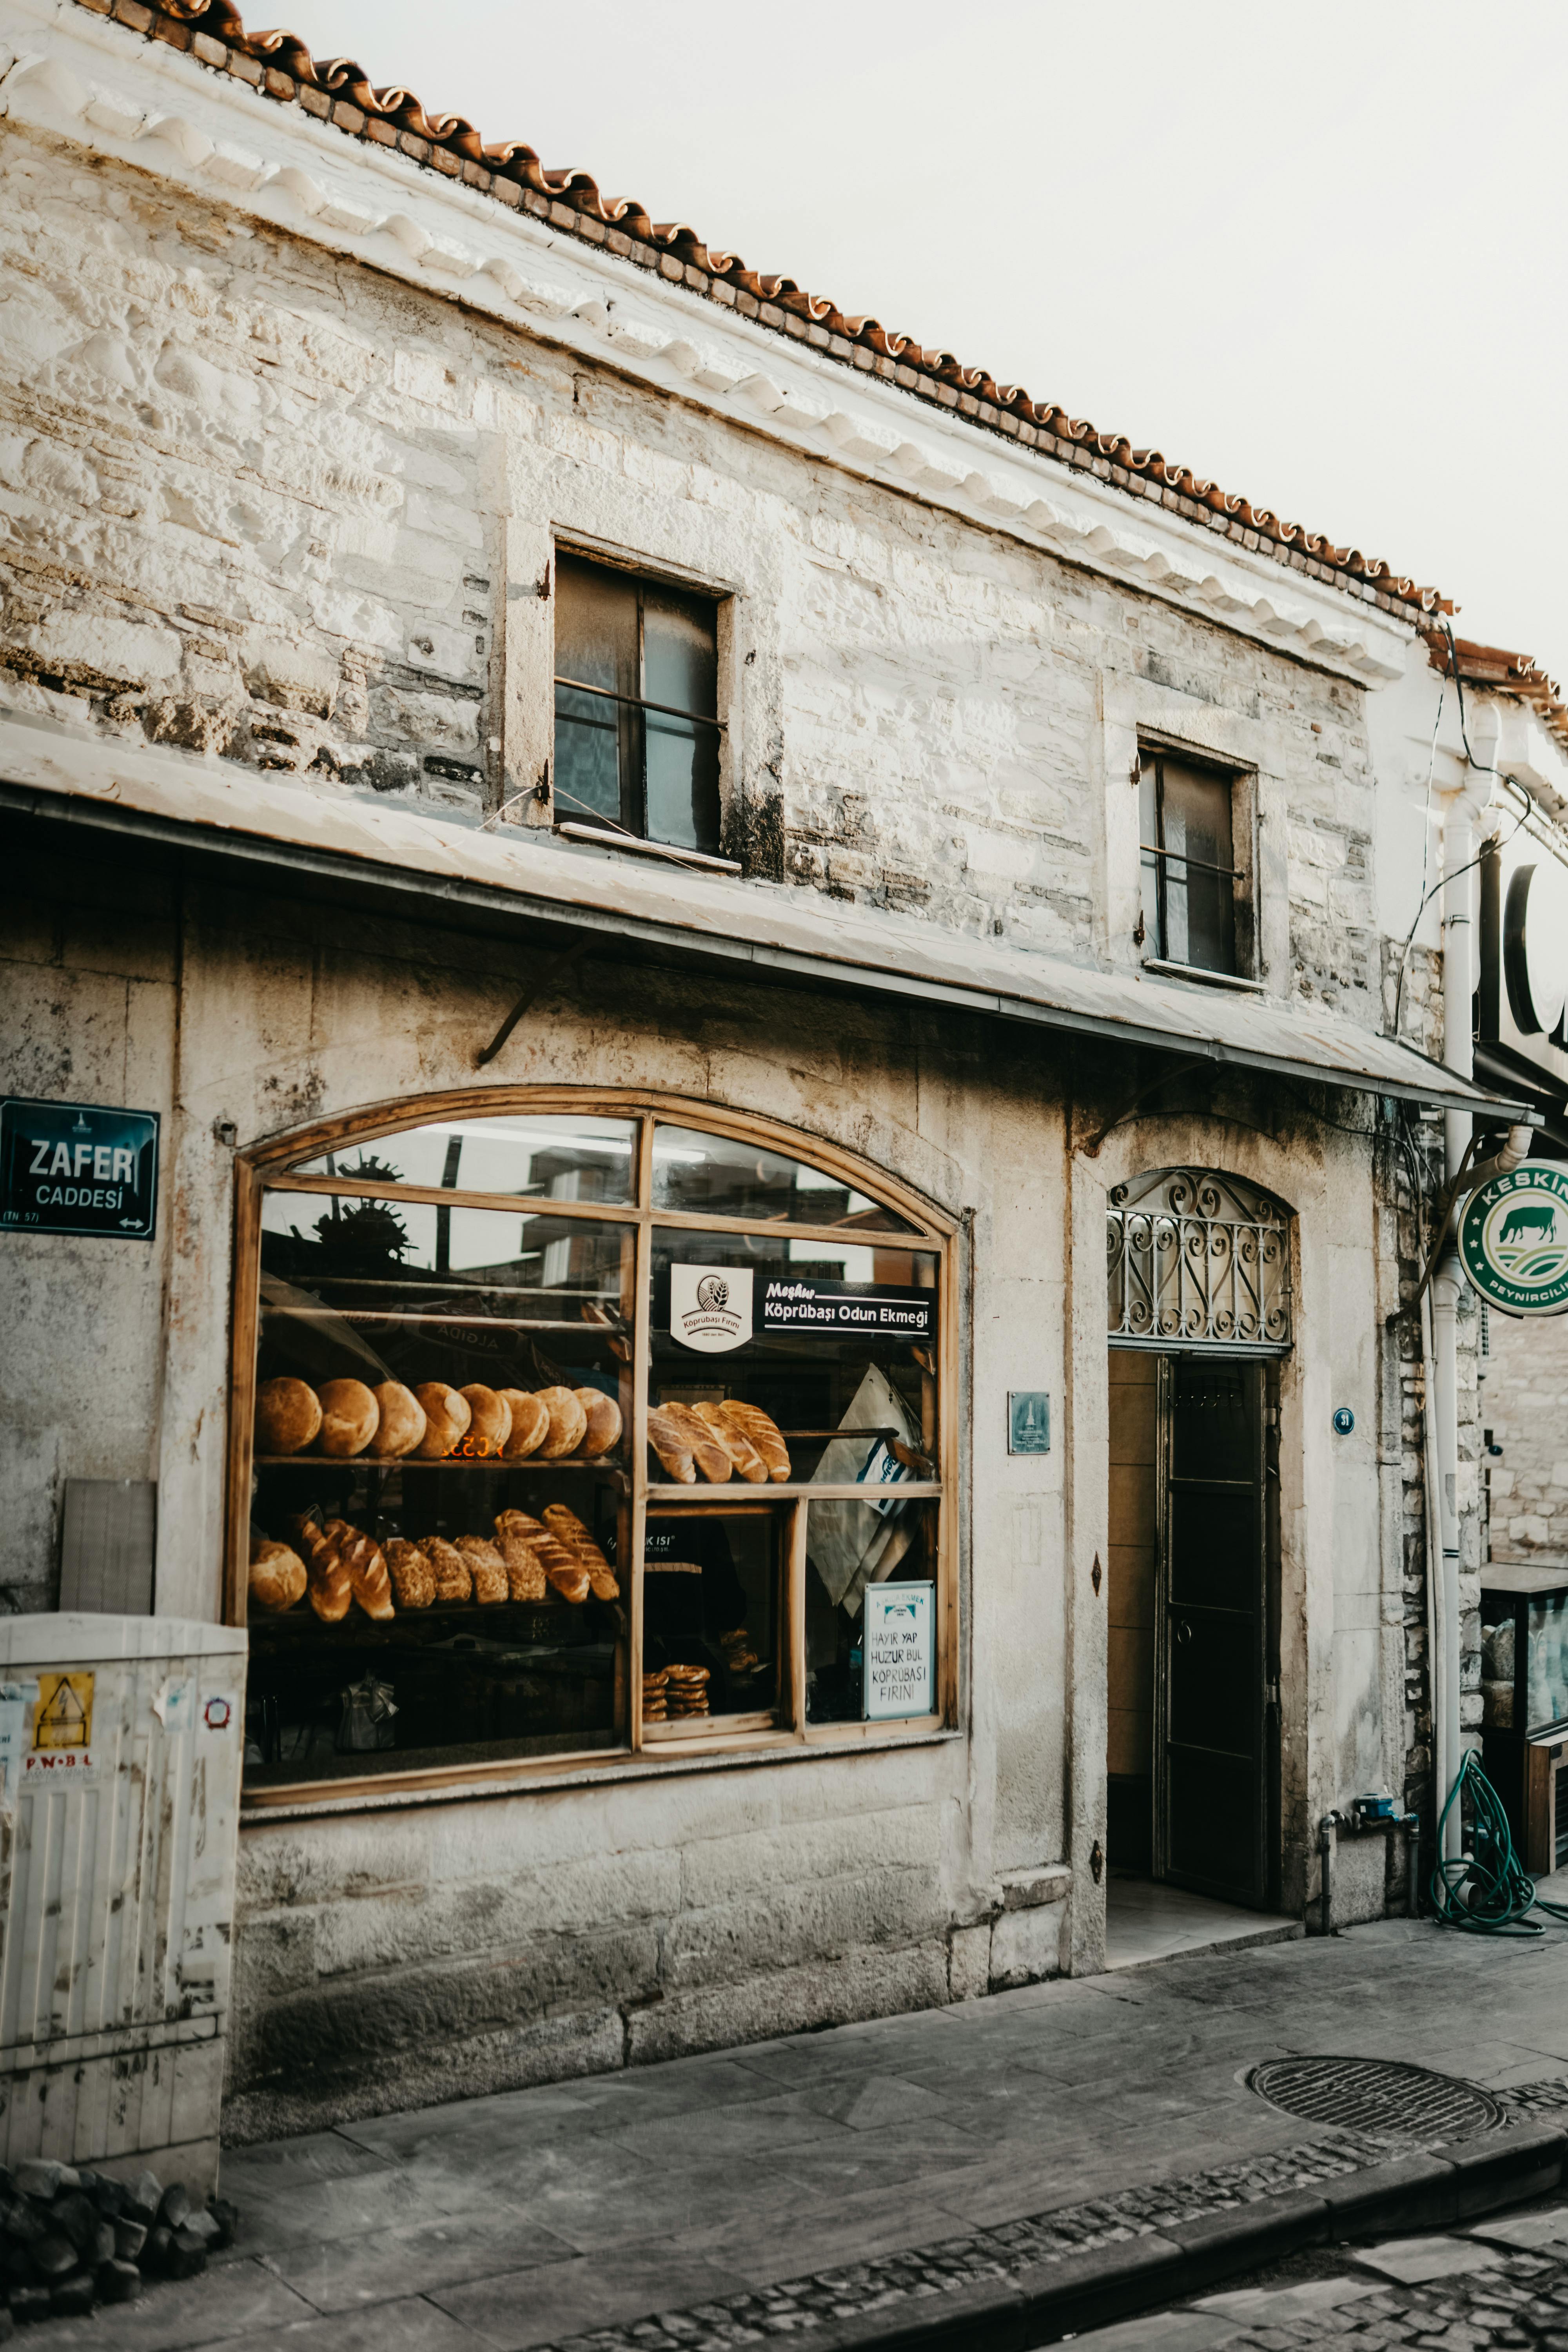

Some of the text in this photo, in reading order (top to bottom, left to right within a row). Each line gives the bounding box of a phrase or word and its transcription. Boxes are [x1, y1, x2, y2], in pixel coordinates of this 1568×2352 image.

[29, 1139, 133, 1183] ZAFER
[36, 1184, 123, 1210] CADDESİ
[25, 1212, 39, 1223] 57)
[766, 1283, 815, 1301] Meşhur
[683, 1316, 740, 1329] Köprübaşı Fırını
[764, 1302, 928, 1328] Köprübaşı Odun Ekmeği
[1341, 1414, 1349, 1426] 31
[902, 1593, 924, 1605] EKMEK
[872, 1632, 917, 1646] HAYIR YAP
[871, 1649, 922, 1664] HUZUR BUL
[873, 1666, 926, 1684] KÖPRÜBAŞI
[880, 1683, 914, 1702] FIRINI
